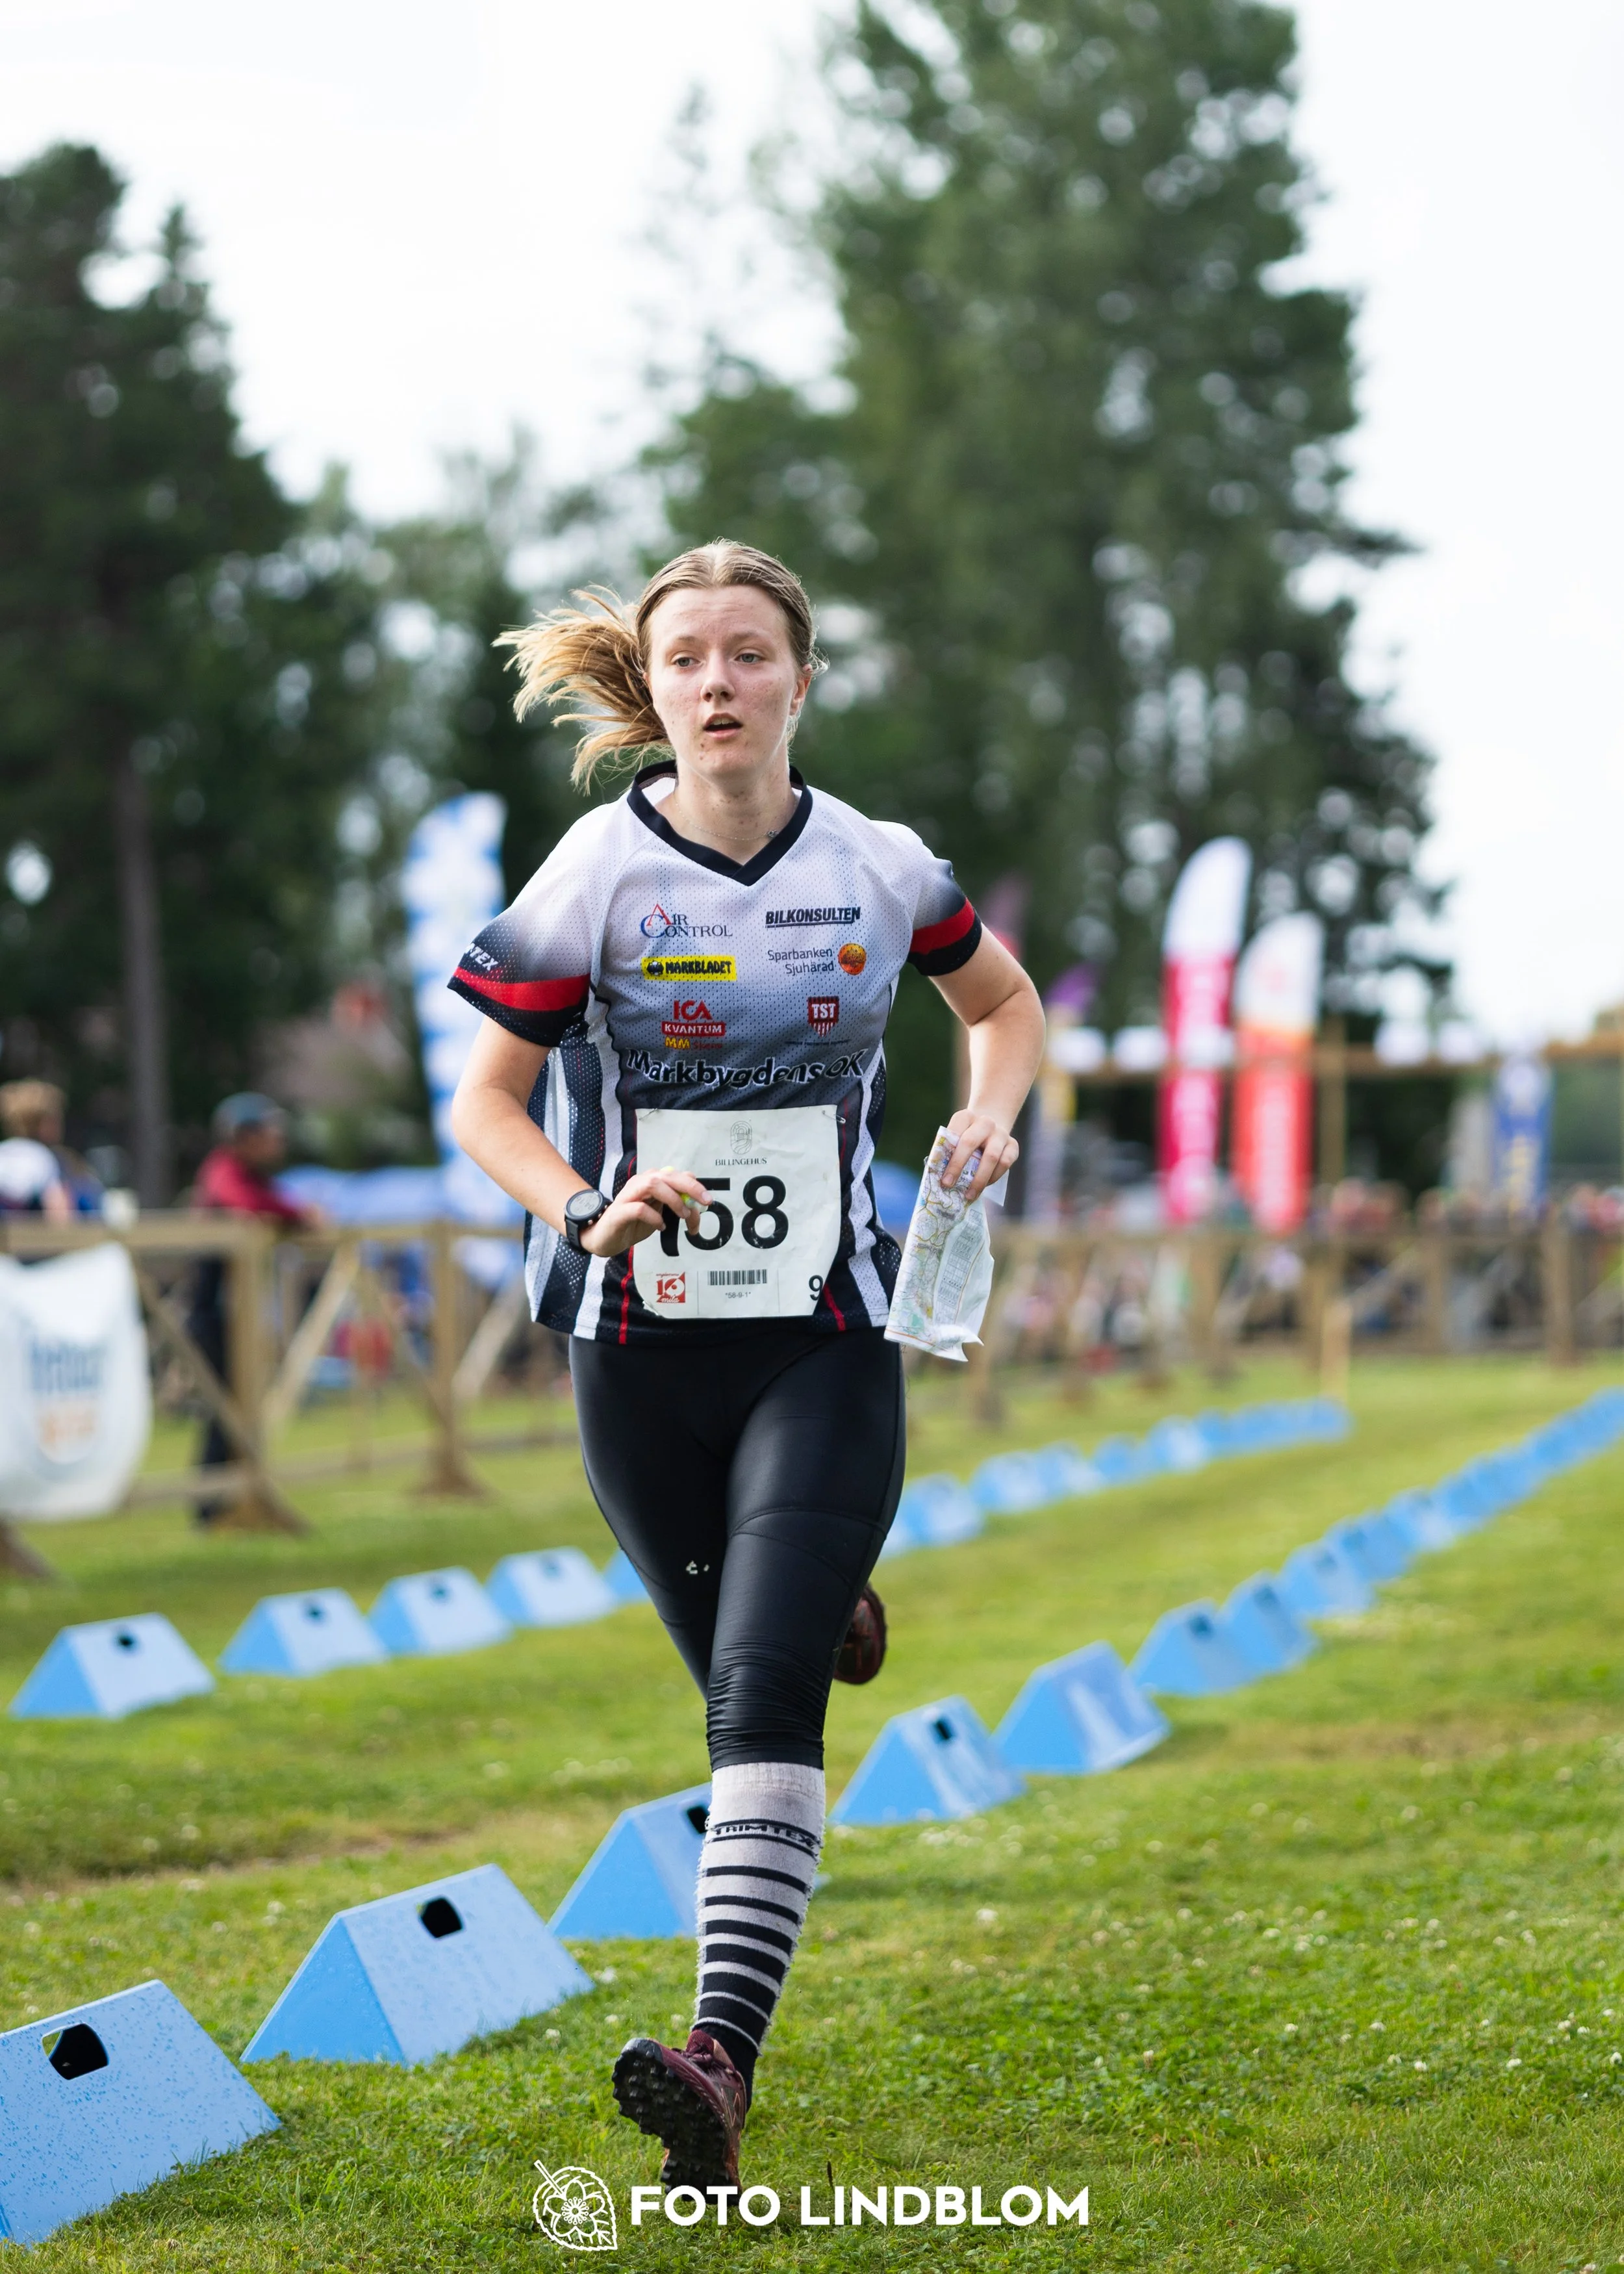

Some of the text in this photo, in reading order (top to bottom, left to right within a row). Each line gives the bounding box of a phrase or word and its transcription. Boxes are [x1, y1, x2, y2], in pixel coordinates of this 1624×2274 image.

[646, 904, 689, 926] AIR
[765, 906, 861, 925] BILKONSULTEN
[641, 913, 733, 938] CONTROL
[767, 947, 833, 963] Sparbanken
[665, 960, 732, 975] MARKBLADET
[785, 960, 835, 976] Sjuhärad
[673, 999, 713, 1021] ICA
[811, 1003, 836, 1019] TST
[665, 1023, 722, 1034] KVANTUM
[626, 1047, 869, 1090] Markbygdens OK
[715, 1157, 768, 1166] BILLINGEHUS
[808, 1274, 824, 1301] 9
[713, 1824, 814, 1850] TRIMTEX
